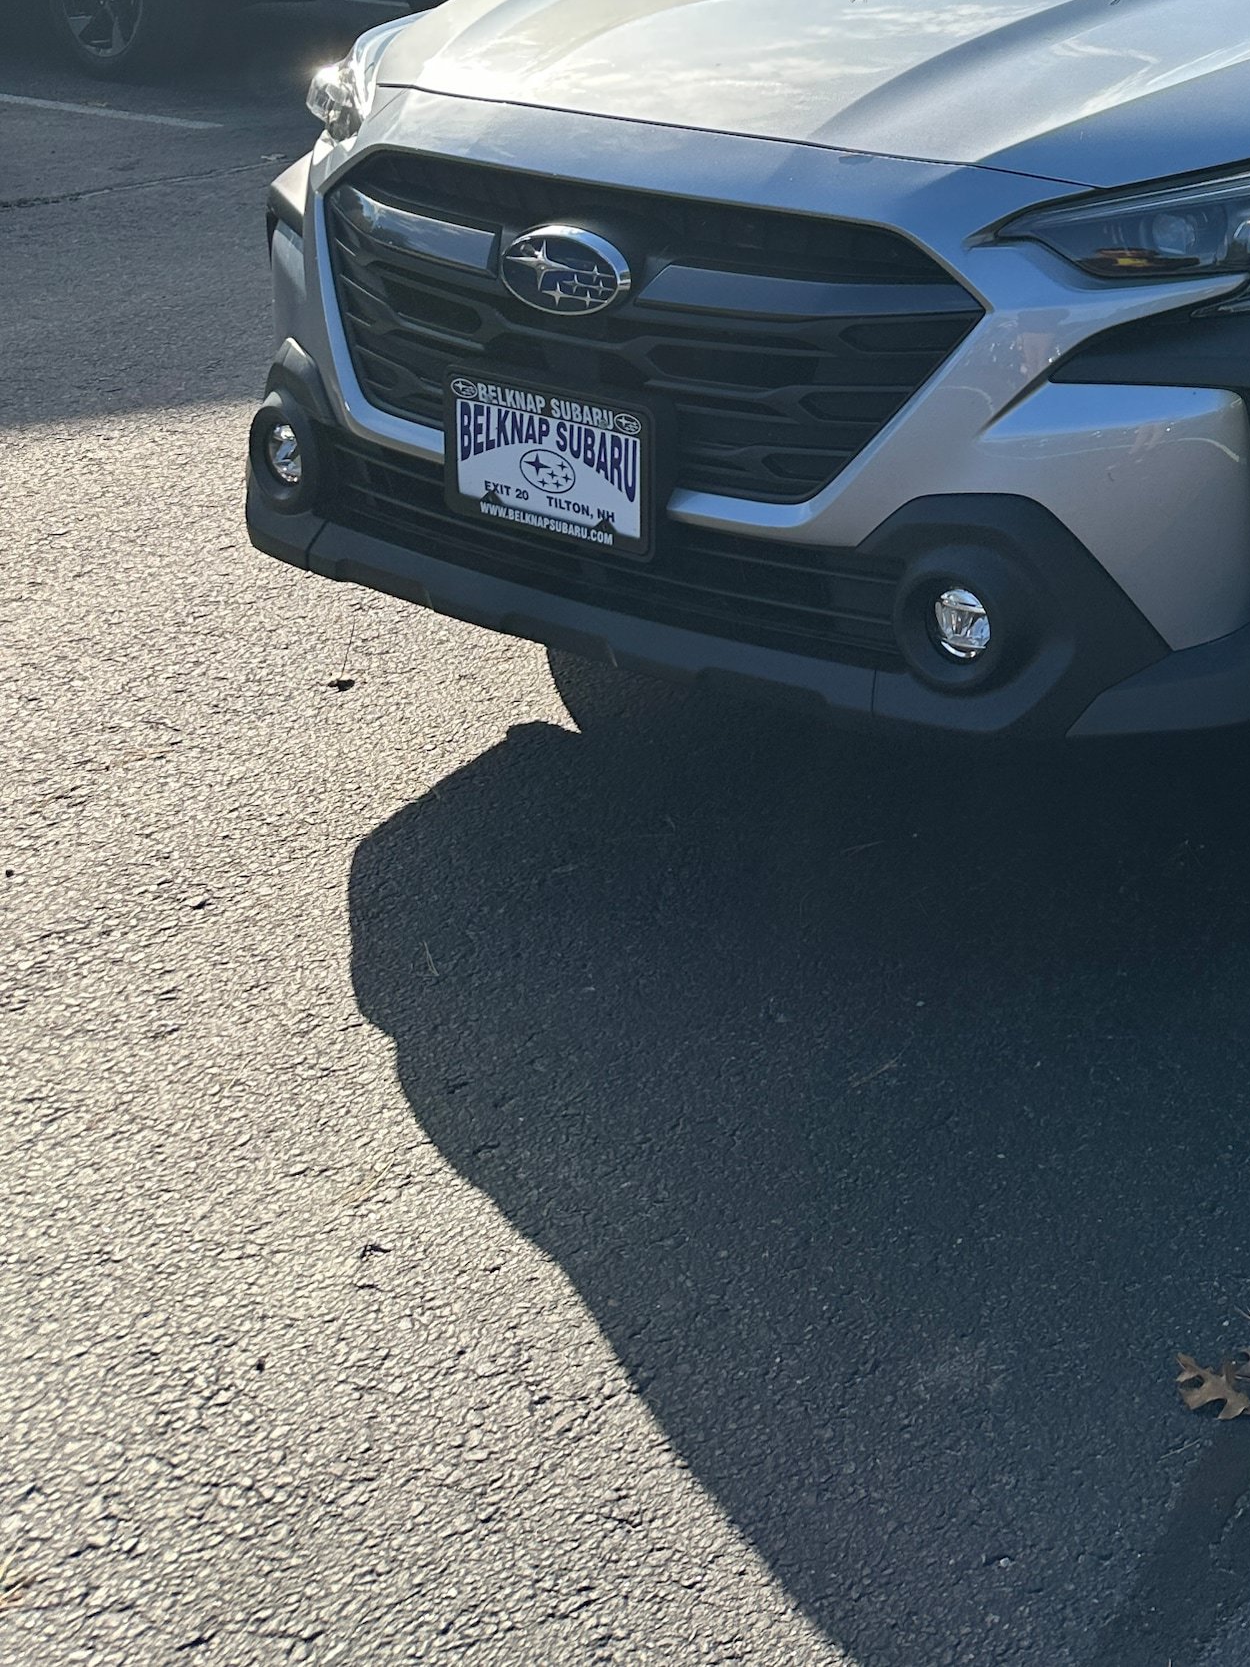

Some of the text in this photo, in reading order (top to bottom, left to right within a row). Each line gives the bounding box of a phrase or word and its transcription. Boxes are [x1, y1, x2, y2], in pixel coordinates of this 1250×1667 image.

[477, 382, 615, 430] BELKNAP SUBARU
[460, 401, 637, 503] BELKNAP SUBARU
[479, 501, 613, 546] WWW.BELKNAPSUBARU.COM
[484, 480, 615, 523] EXIT 20 TILTON, NH
